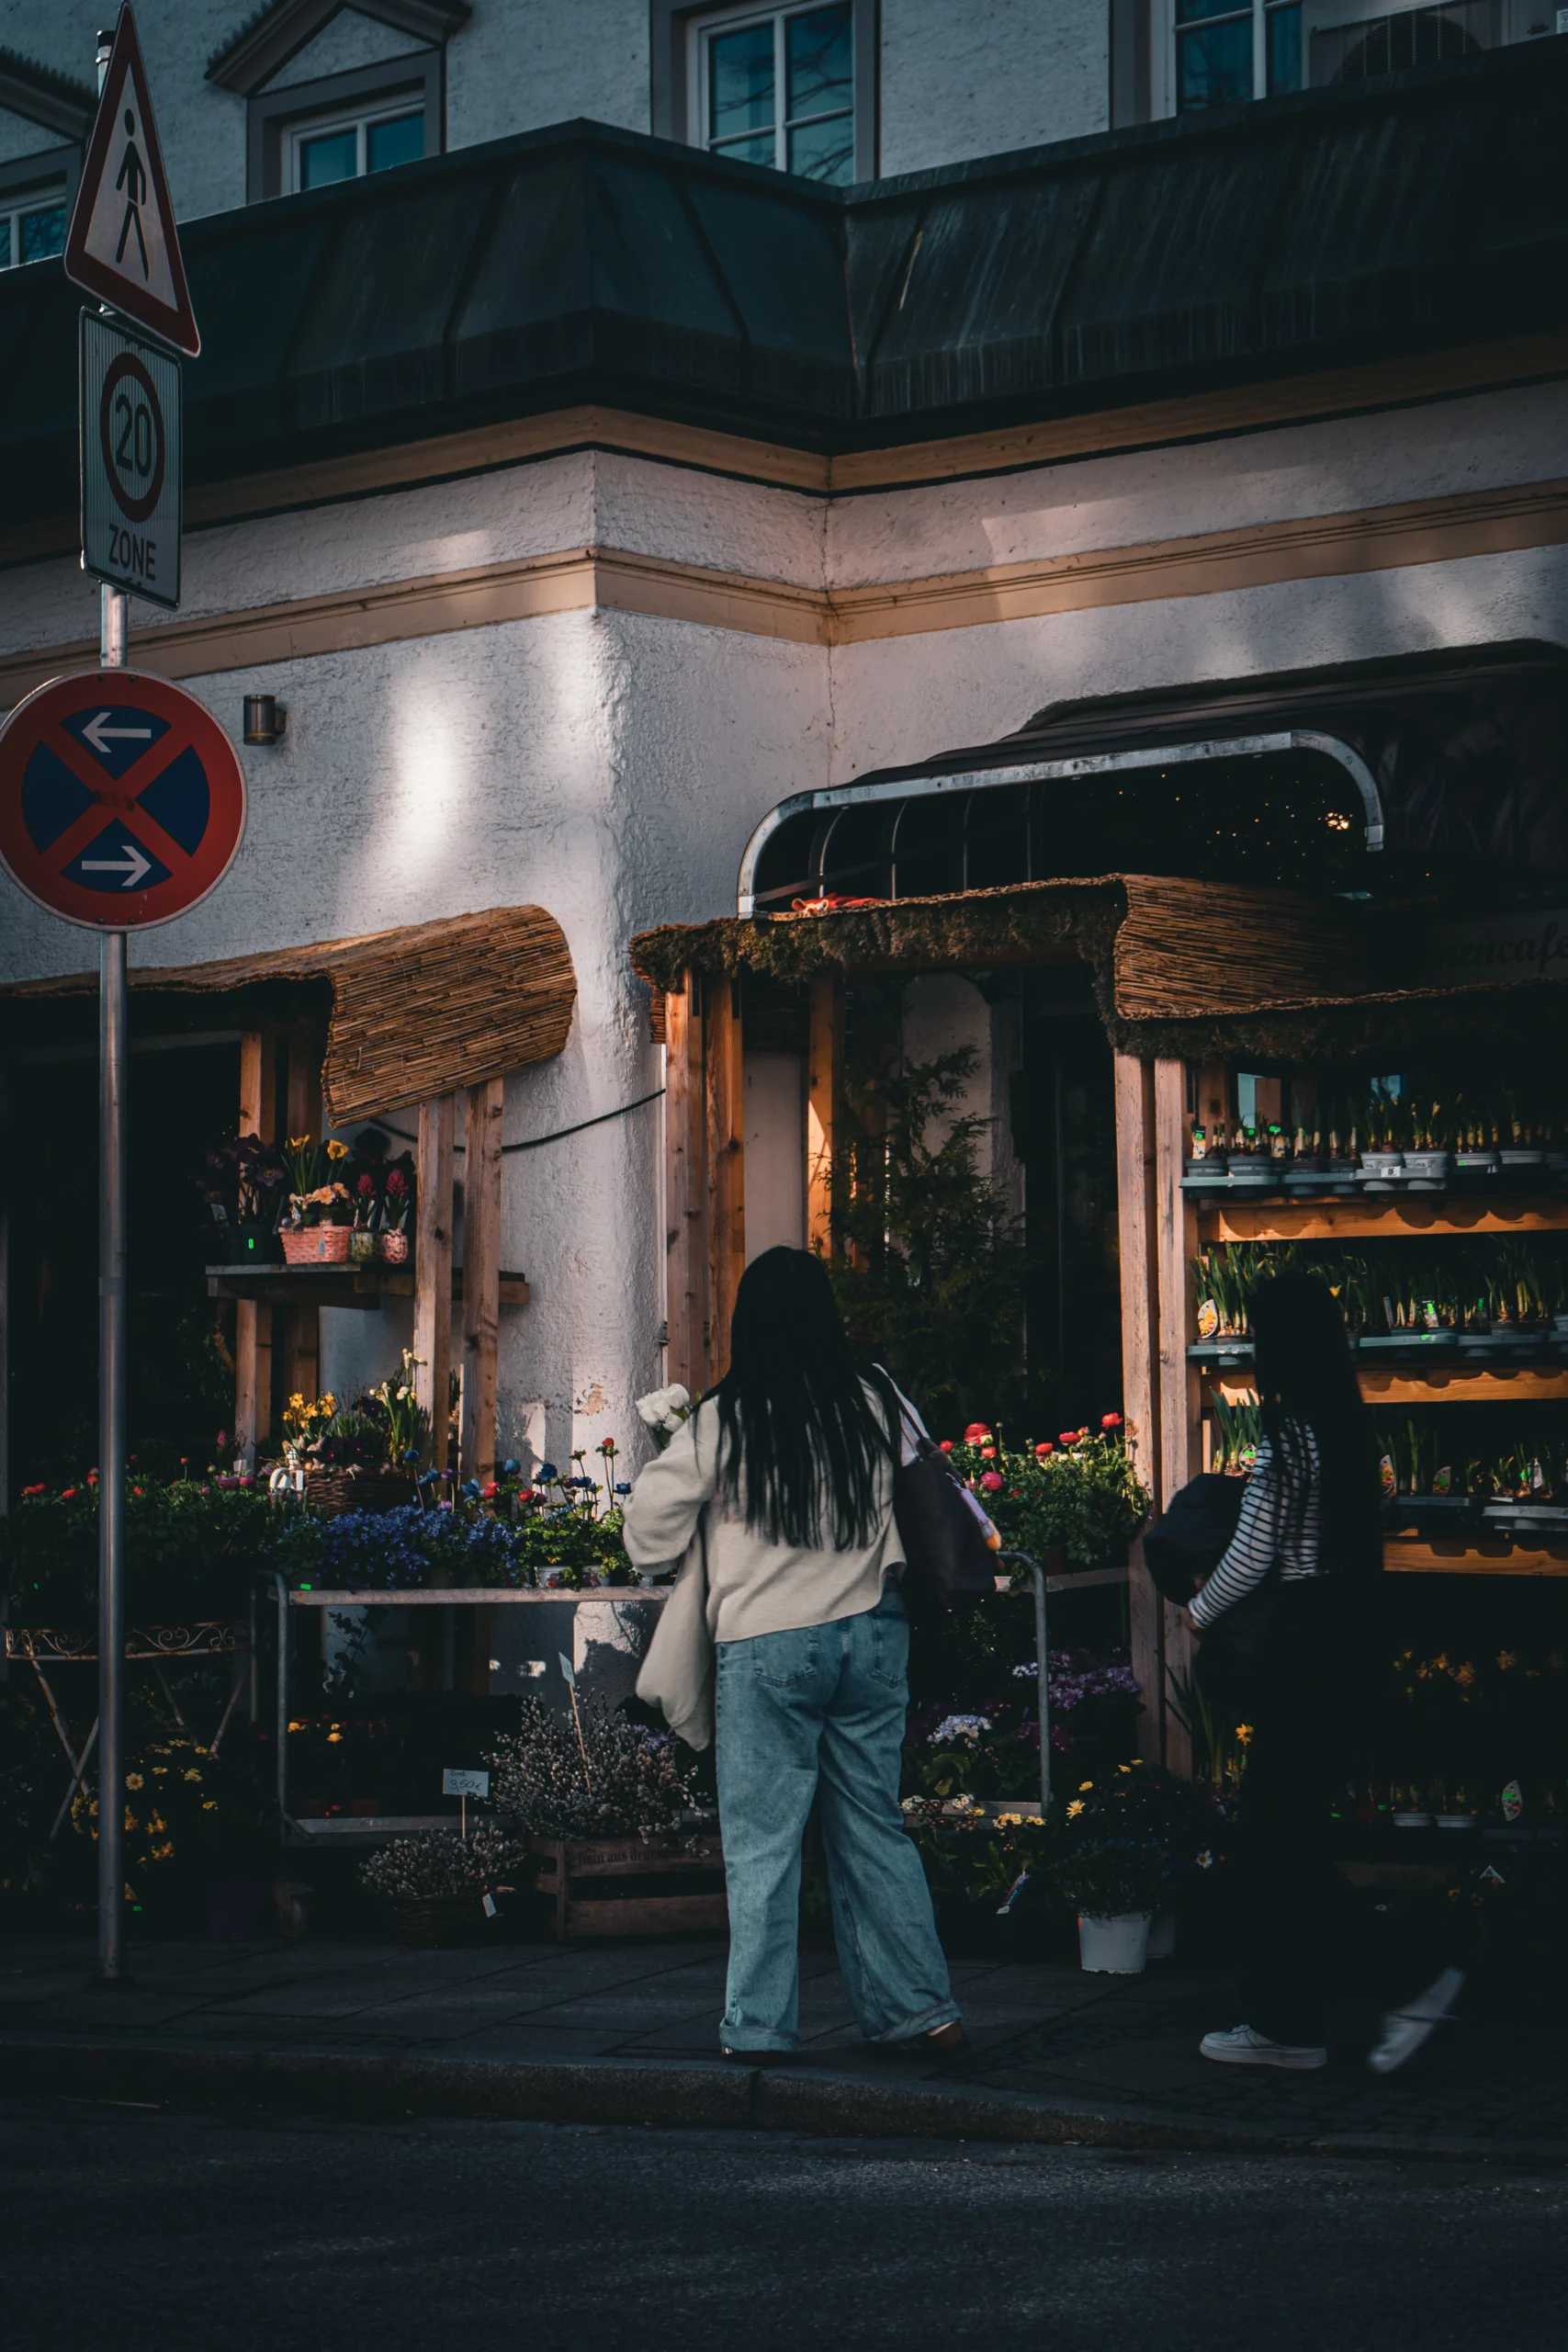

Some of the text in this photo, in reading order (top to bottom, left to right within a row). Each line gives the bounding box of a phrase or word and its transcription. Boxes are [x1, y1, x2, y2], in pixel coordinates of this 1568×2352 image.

[116, 394, 151, 477] 20
[108, 524, 155, 581] ZONE
[607, 1851, 626, 1863] aus
